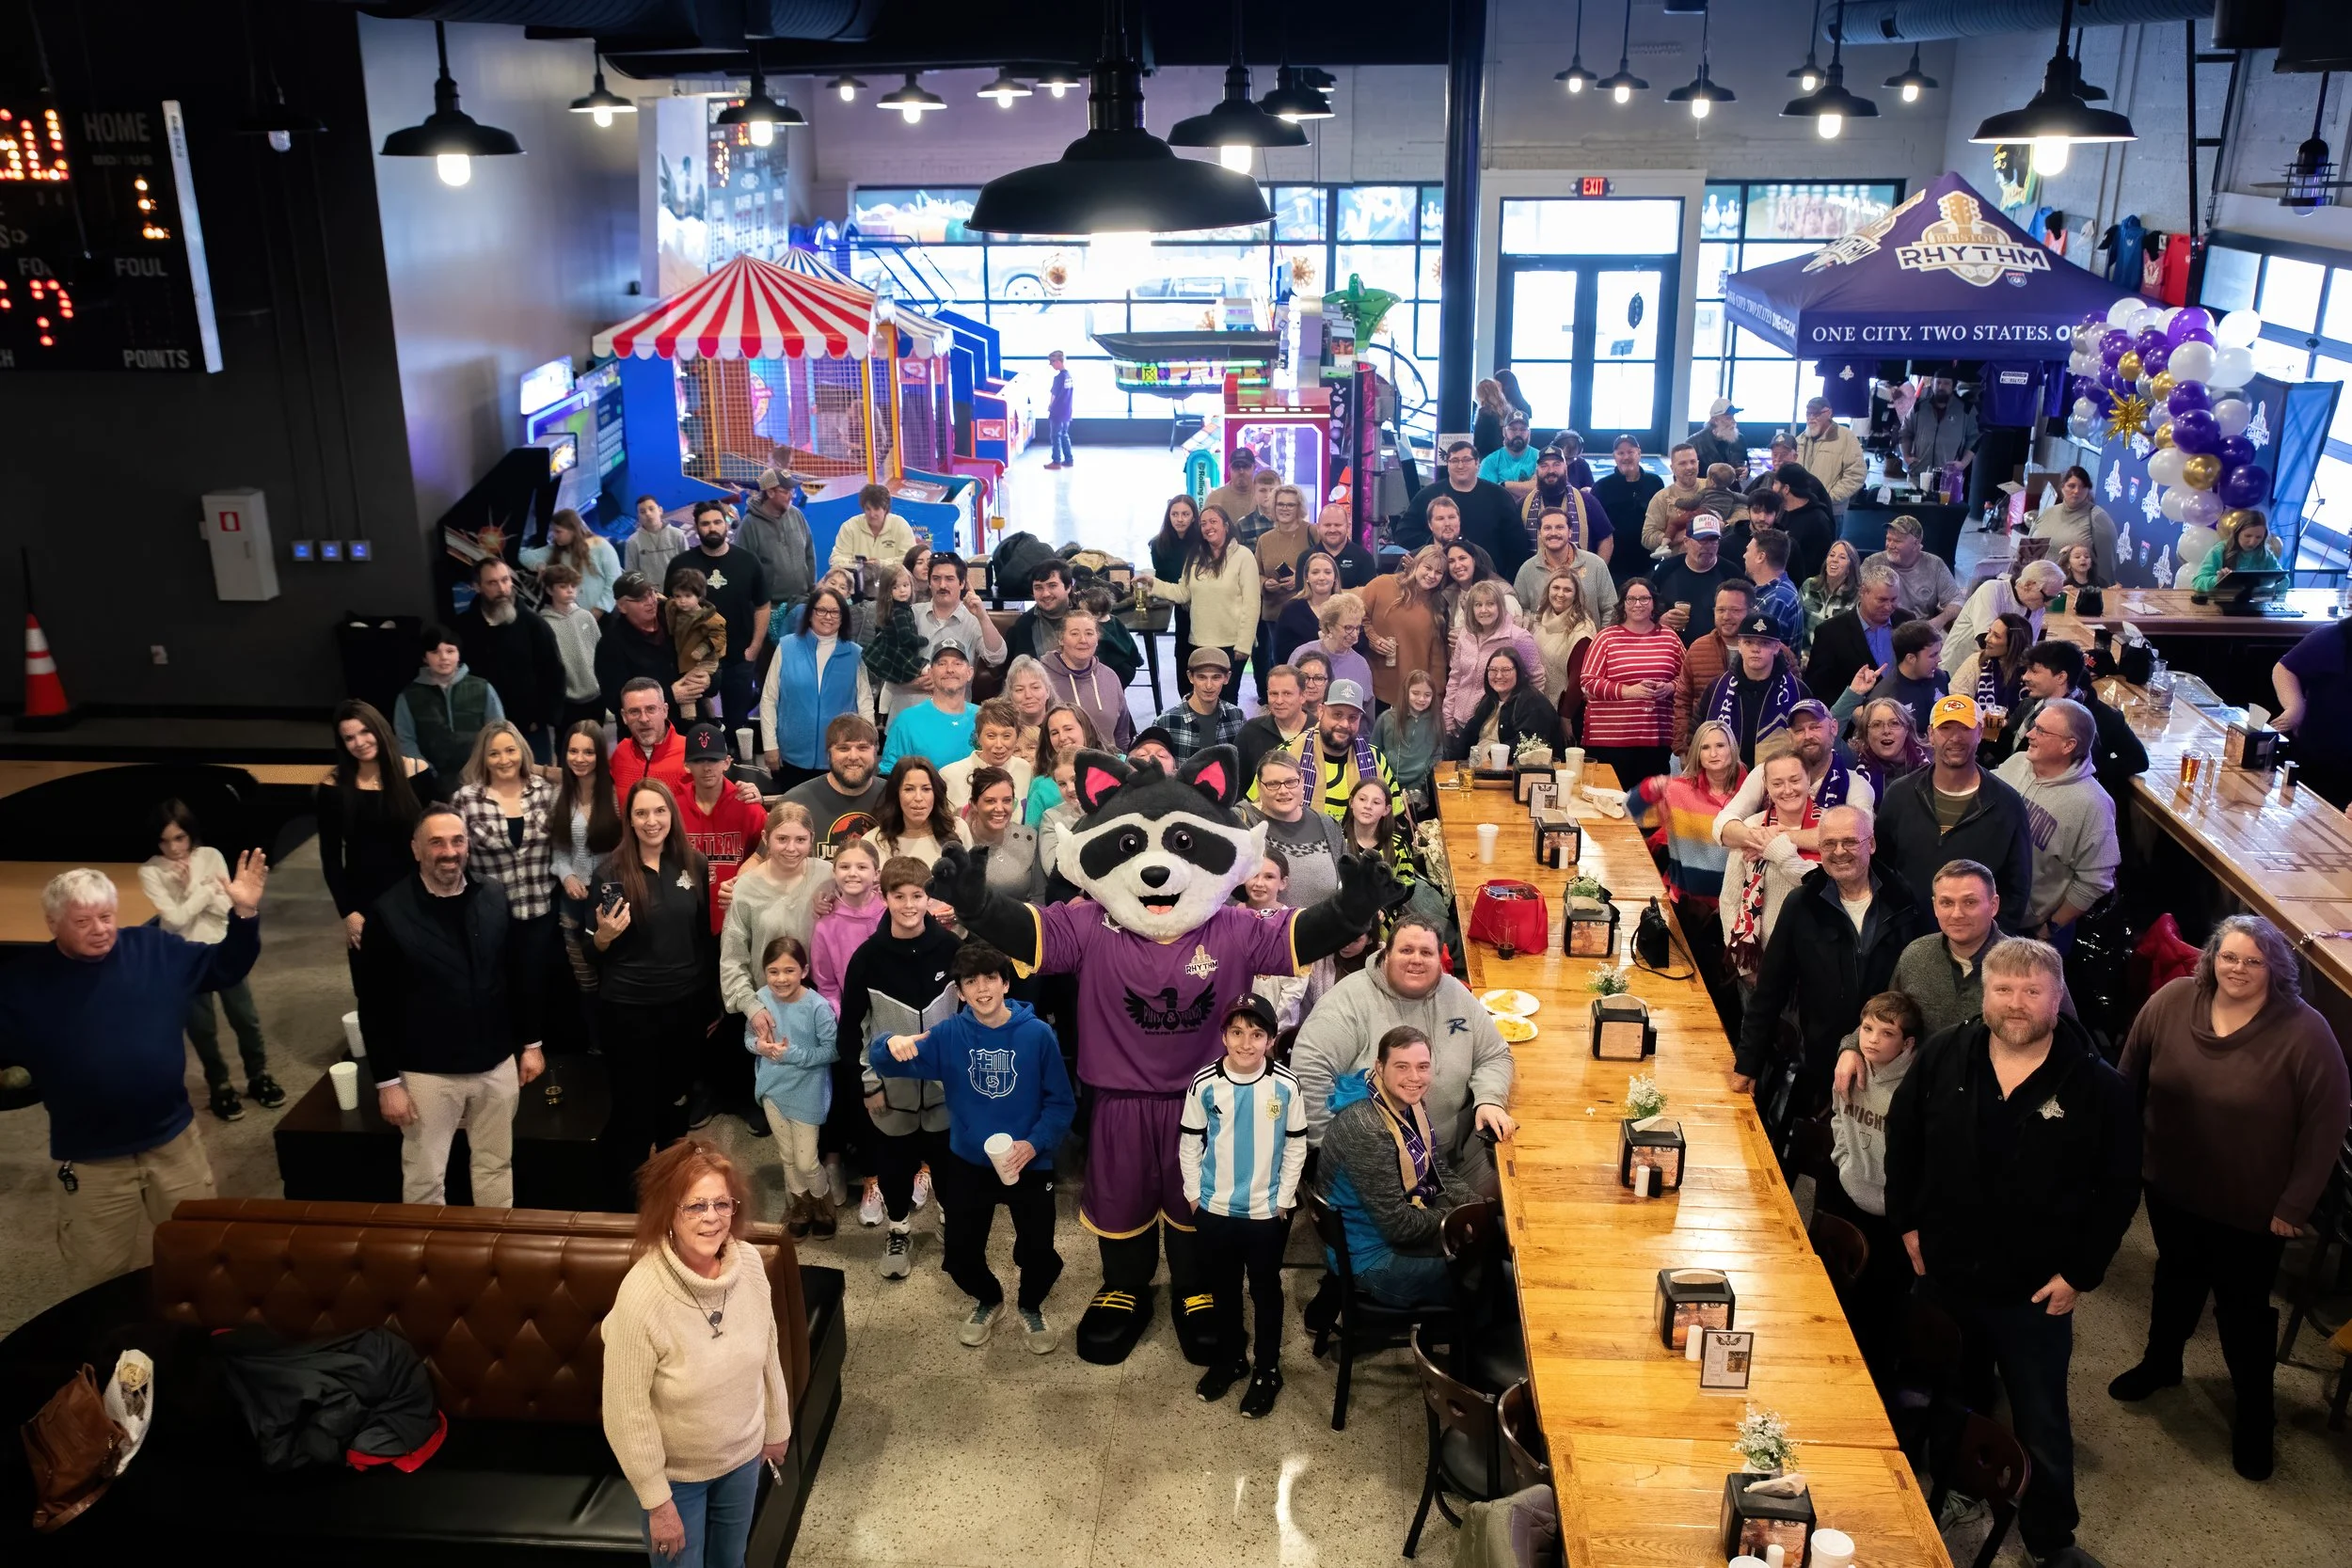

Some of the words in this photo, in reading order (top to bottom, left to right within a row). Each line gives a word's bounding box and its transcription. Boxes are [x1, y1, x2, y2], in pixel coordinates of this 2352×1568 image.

[83, 112, 151, 142] HOME
[1582, 178, 1604, 195] EXIT
[1935, 233, 1998, 244] BRISTOL
[1900, 245, 2045, 267] RHYTHM
[114, 257, 168, 277] FOUL
[1812, 326, 1855, 341] ONE
[1863, 326, 1913, 341] CITY.
[1920, 326, 1966, 341] TWO
[1973, 325, 2052, 341] STATES.
[122, 349, 190, 370] POINTS
[1186, 960, 1218, 974] RHYTHM
[1143, 1005, 1161, 1023] PINS
[1446, 1018, 1470, 1035] R
